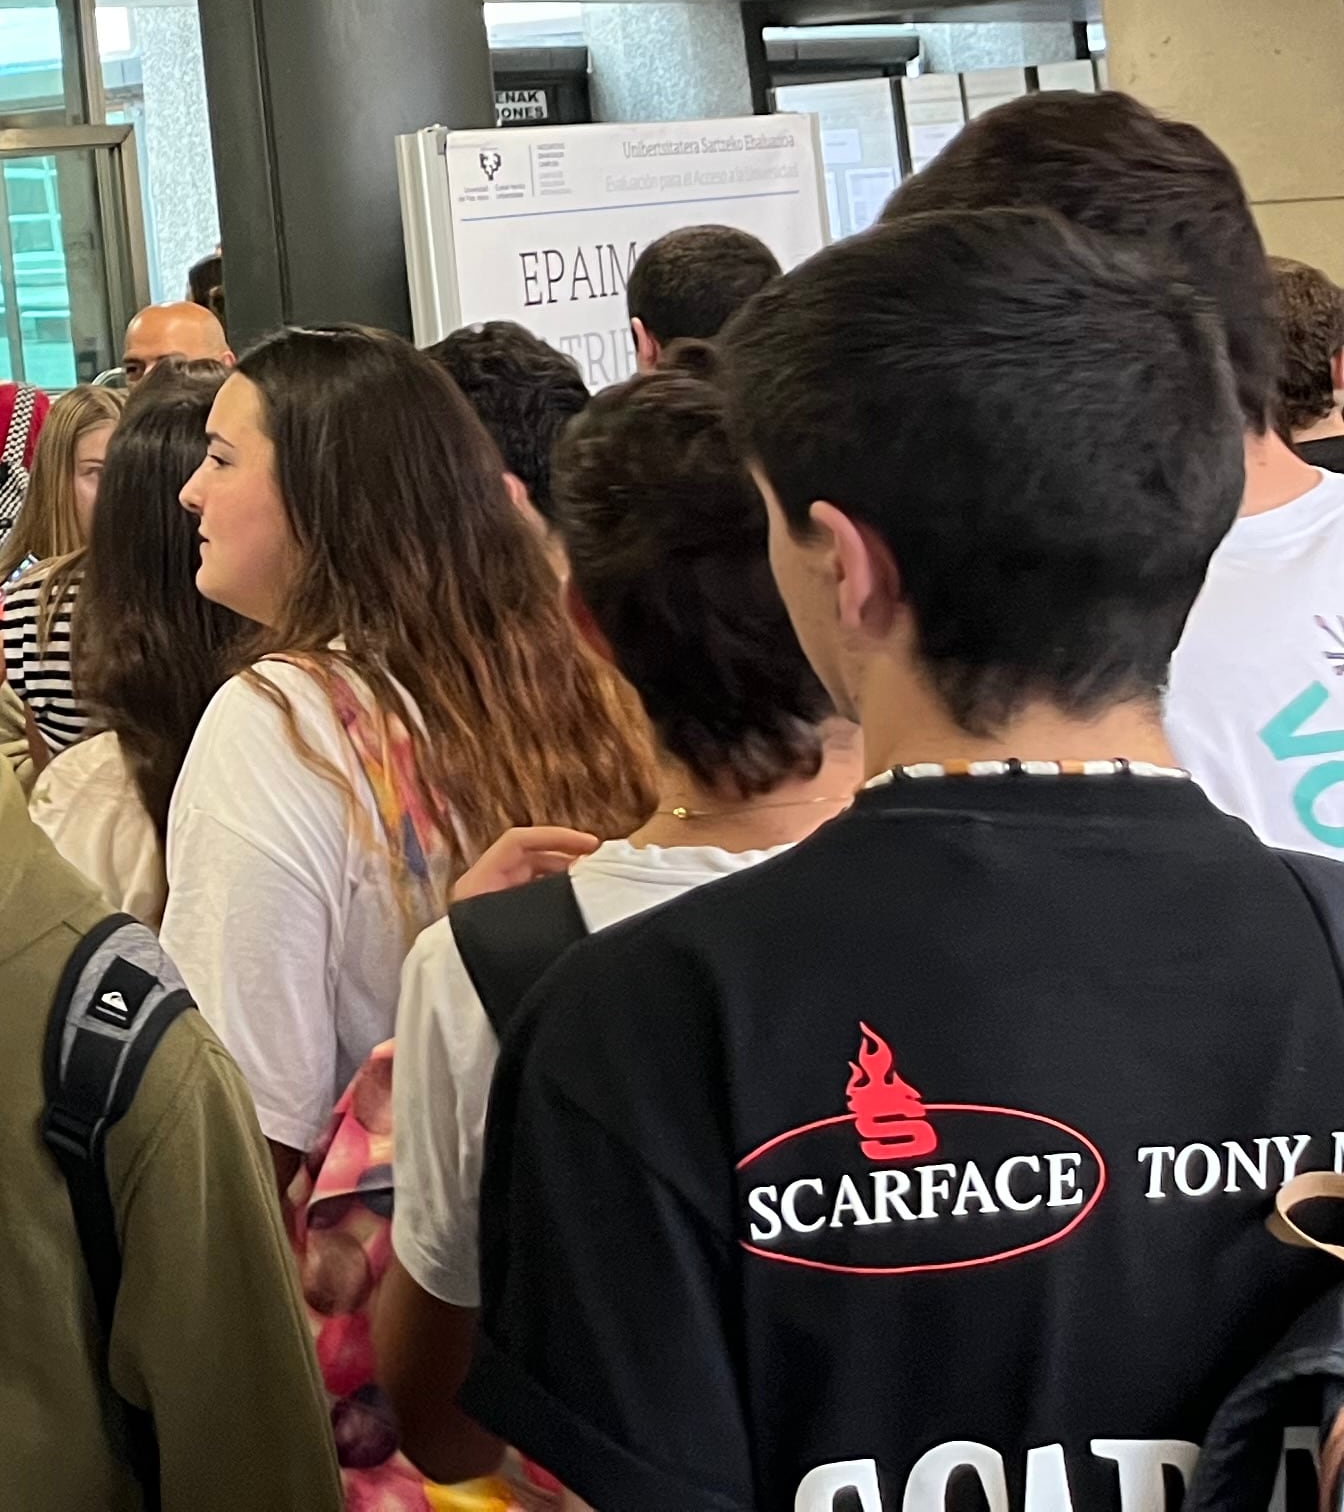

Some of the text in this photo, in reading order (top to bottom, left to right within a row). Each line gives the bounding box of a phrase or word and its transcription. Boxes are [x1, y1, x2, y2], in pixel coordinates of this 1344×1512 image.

[519, 241, 638, 306] EPAIM
[748, 1151, 1084, 1241] SCARFACE
[1137, 1133, 1311, 1201] TONY
